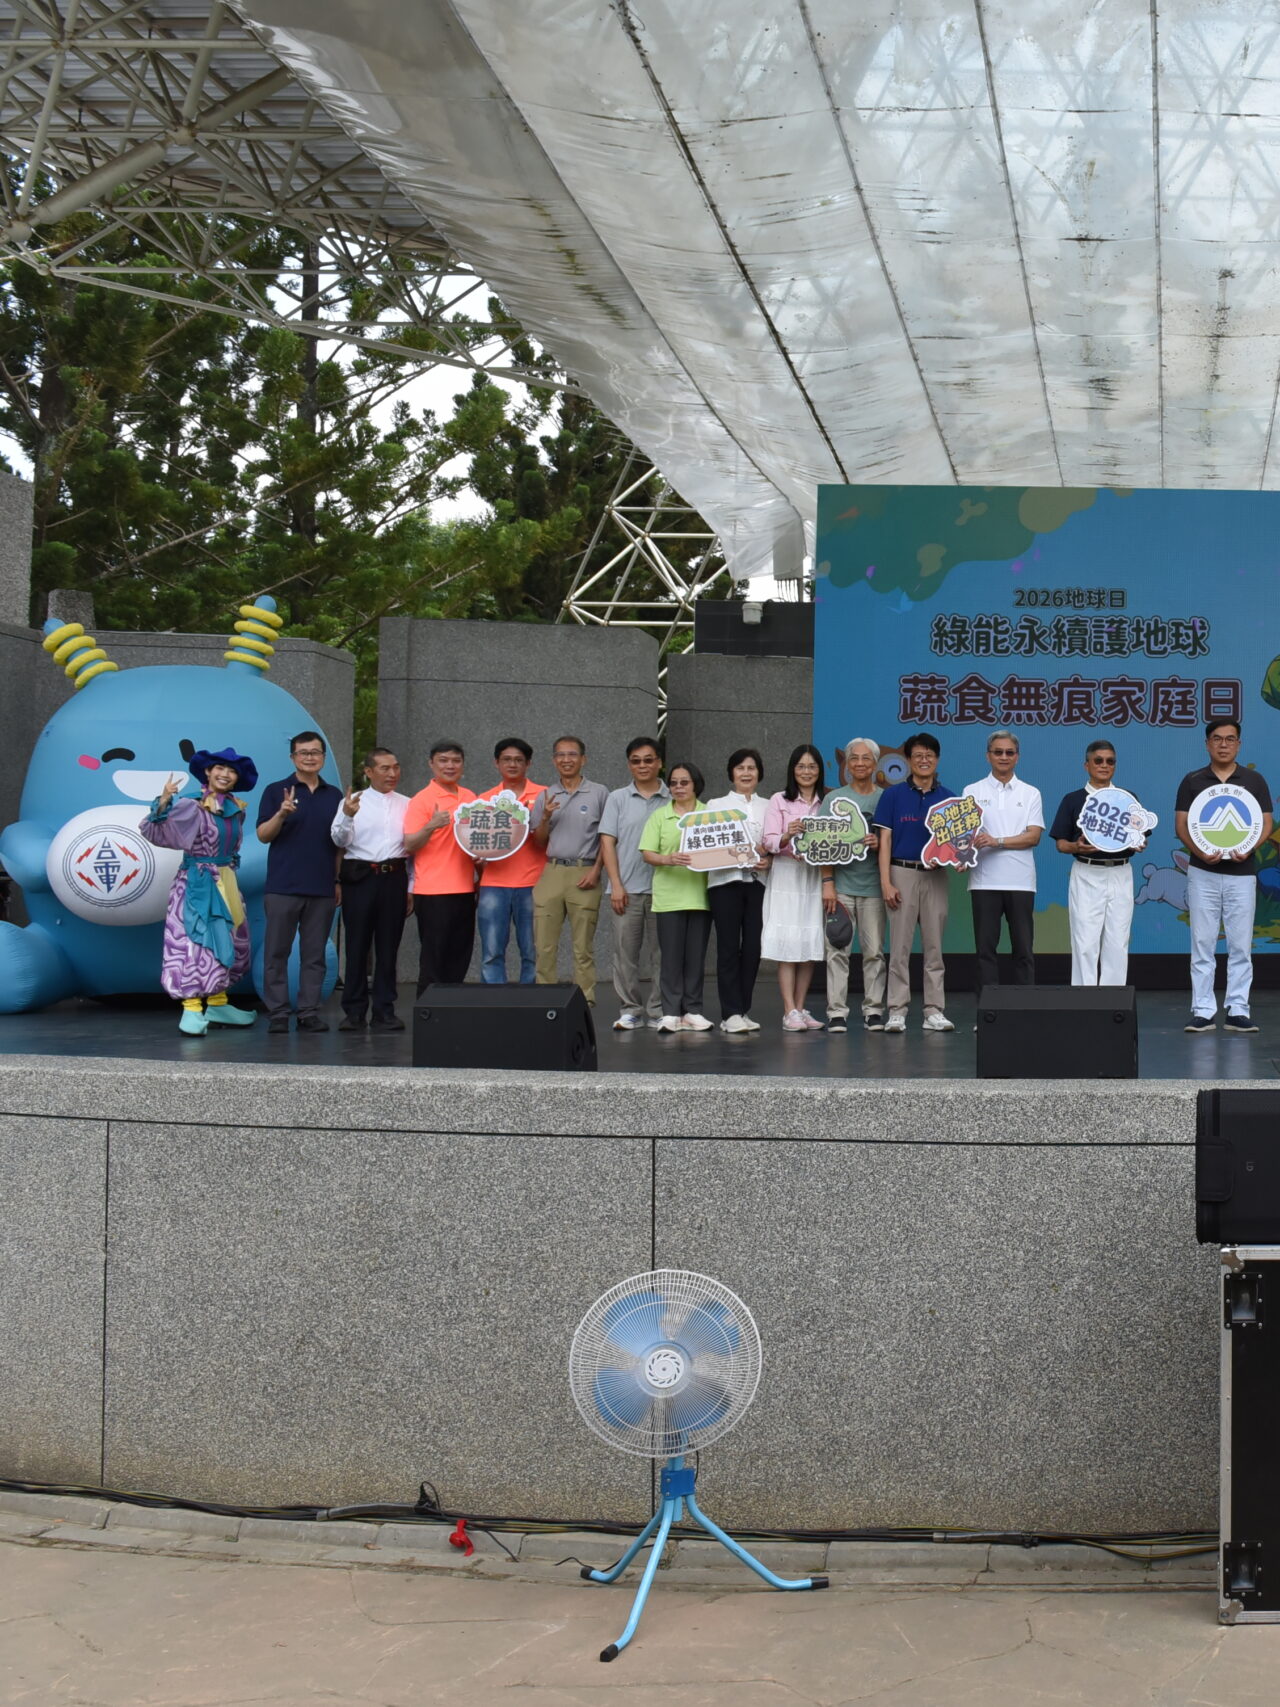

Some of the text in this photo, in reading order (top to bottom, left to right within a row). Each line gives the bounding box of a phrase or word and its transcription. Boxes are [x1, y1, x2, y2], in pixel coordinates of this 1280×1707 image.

[1013, 588, 1128, 609] 2026地球日
[930, 614, 1211, 659] 綠能永續護地球
[898, 672, 1244, 728] 蔬食無痕家庭日
[1208, 787, 1244, 798] 環境部
[469, 809, 513, 830] 蔬食
[930, 795, 976, 831] 為地球
[1086, 797, 1132, 826] 2026
[804, 820, 851, 834] 地球有力
[936, 811, 980, 847] 出任務
[1080, 811, 1129, 844] 地球日
[1191, 822, 1211, 851] Ministry
[469, 830, 513, 851] 無痕
[687, 830, 745, 851] 綠色市集
[809, 839, 853, 861] 給力
